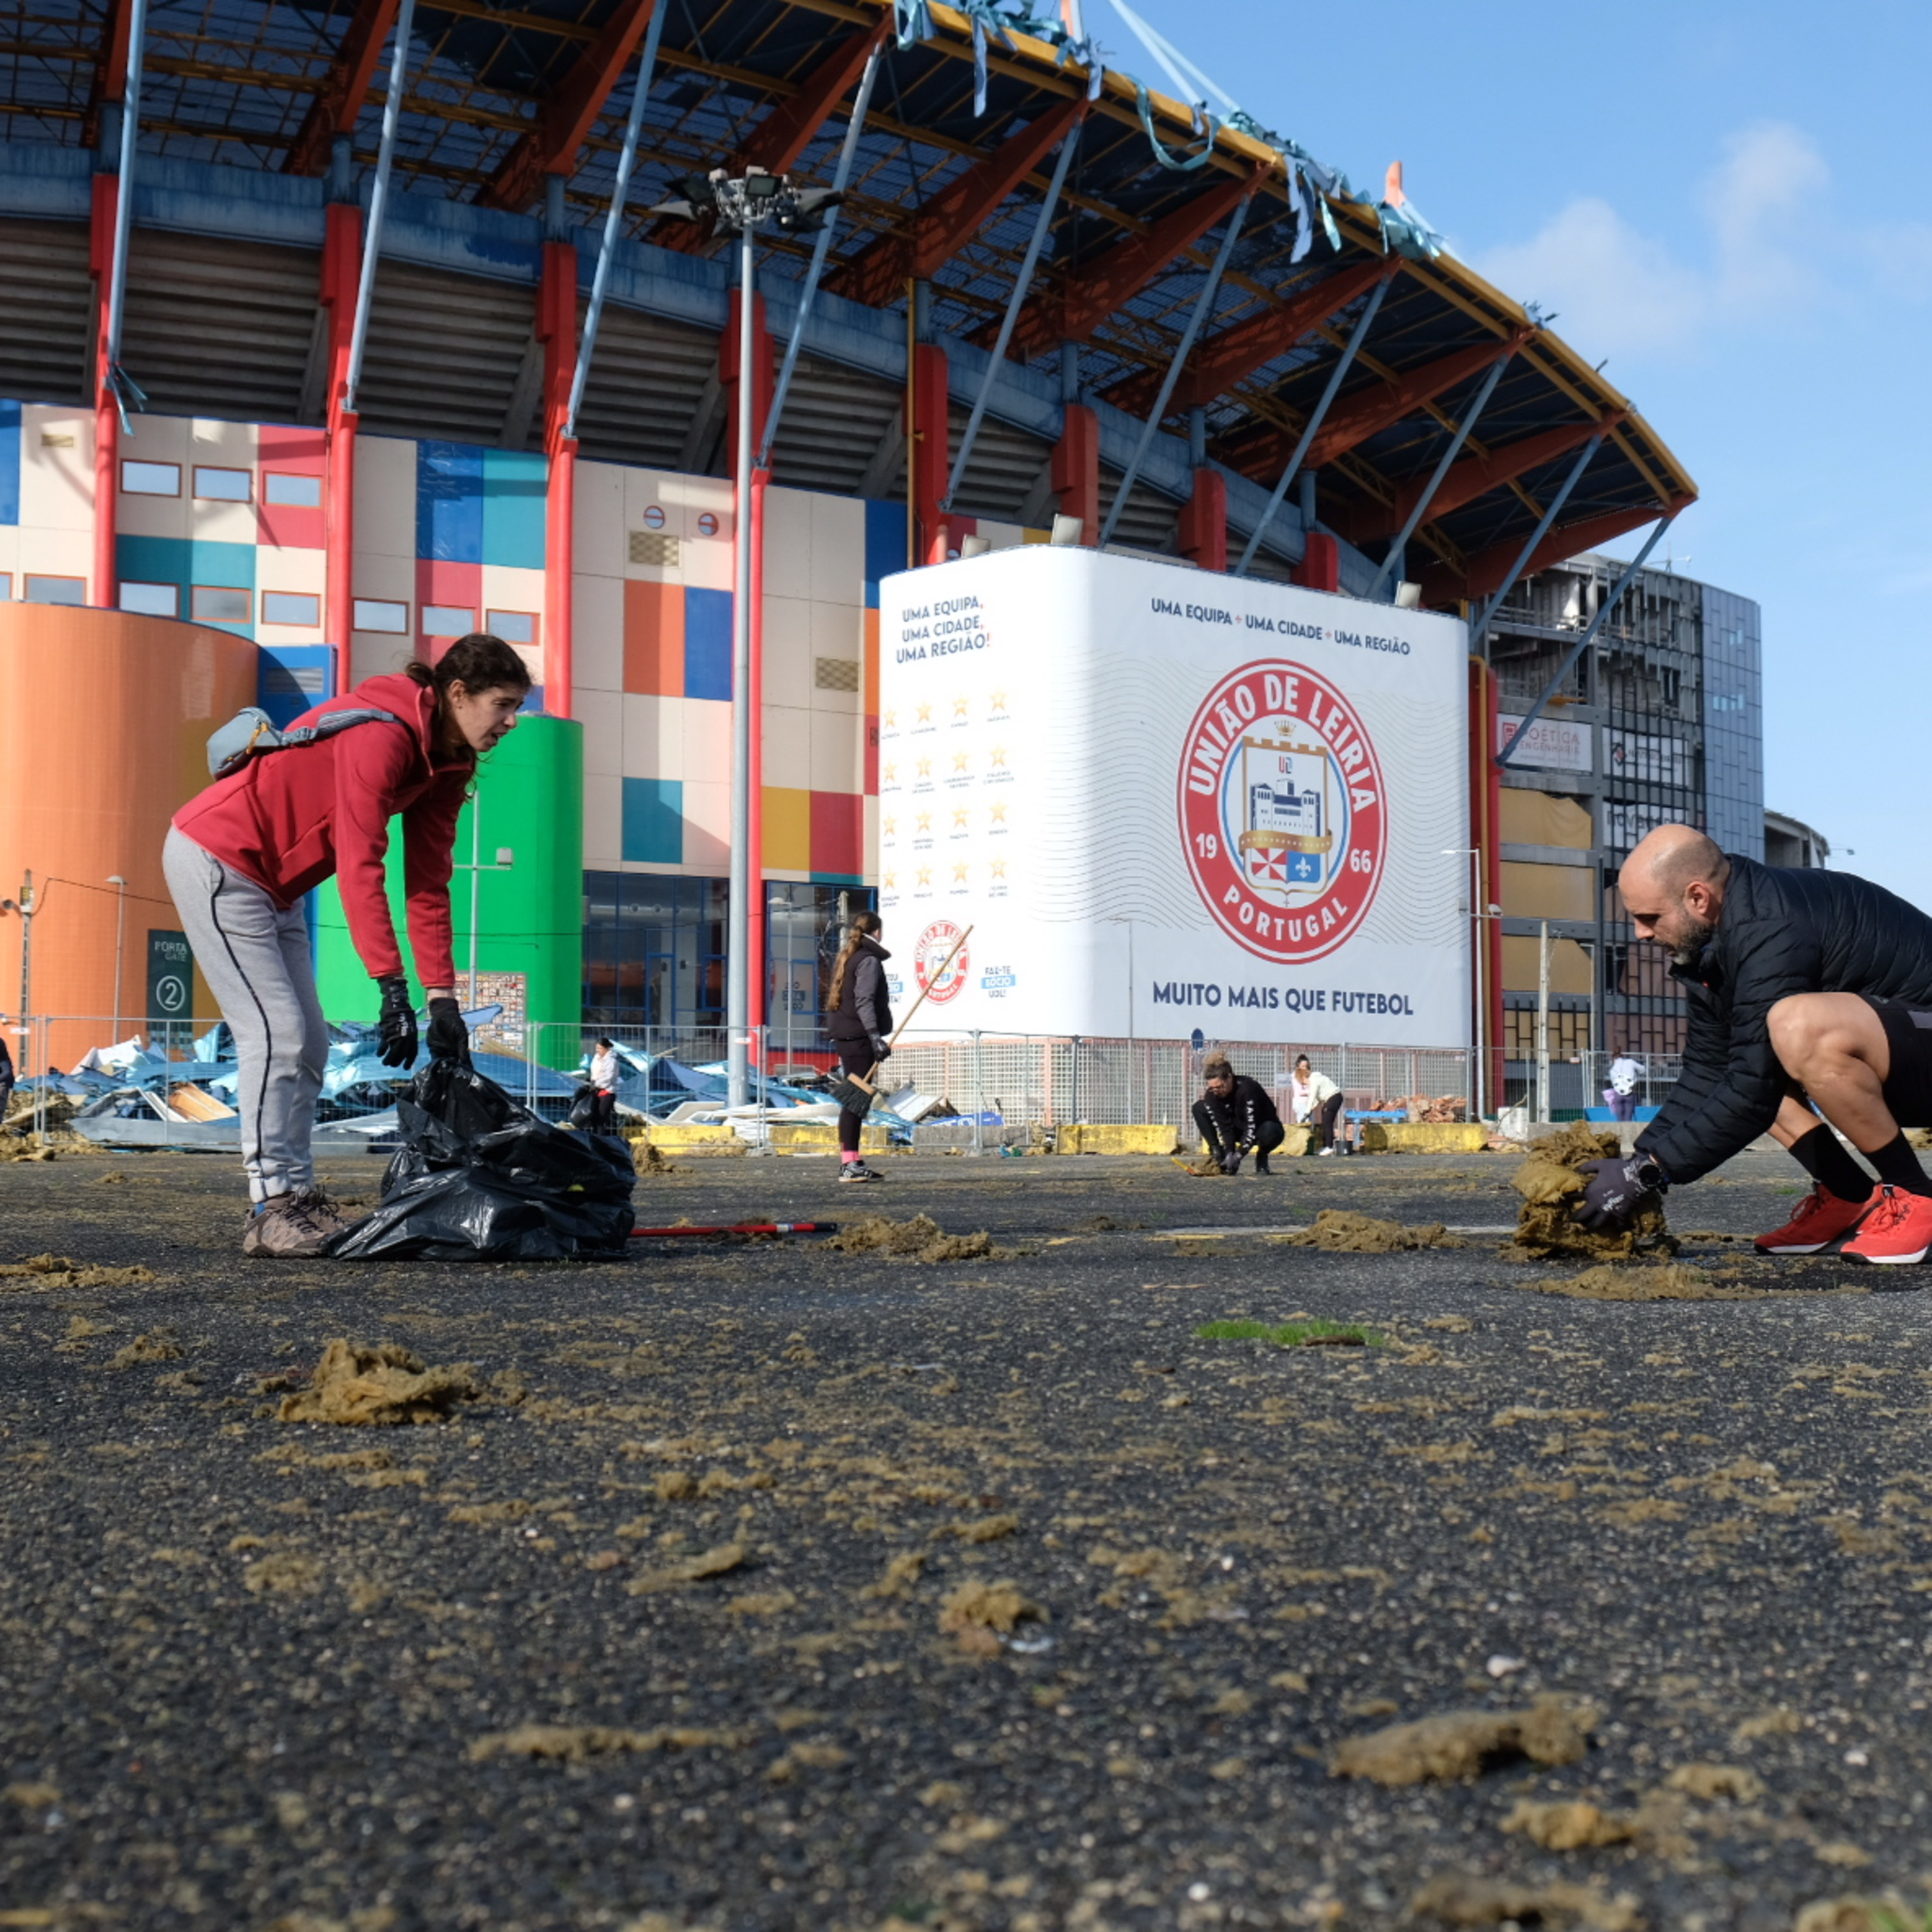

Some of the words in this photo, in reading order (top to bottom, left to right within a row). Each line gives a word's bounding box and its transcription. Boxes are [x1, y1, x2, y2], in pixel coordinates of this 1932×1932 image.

[902, 605, 930, 622] UMA
[934, 595, 983, 616] EQUIPA,
[902, 626, 930, 642] UMA
[934, 615, 983, 636] CIDADE,
[1151, 598, 1182, 616] UMA
[1186, 603, 1233, 625] EQUIPA
[1245, 614, 1275, 632] UMA
[1278, 620, 1323, 640] CIDADE
[1334, 629, 1362, 647] UMA
[1365, 636, 1410, 655] REGIÃO
[896, 645, 926, 663] UMA
[931, 631, 989, 658] REGIÃO!
[1189, 685, 1256, 795] UNIÃO
[1264, 674, 1299, 713] DE
[1308, 690, 1376, 813] LEIRIA
[1525, 726, 1580, 744] OÉTICA
[1196, 833, 1218, 859] 19
[1350, 848, 1372, 873] 66
[1224, 884, 1349, 942] PORTUGAL
[155, 941, 187, 954] PORTA
[165, 952, 186, 961] GATE
[165, 982, 177, 1005] 2
[1153, 981, 1221, 1007] MUITO
[1228, 985, 1279, 1009] MAIS
[1285, 988, 1326, 1014] QUE
[1332, 990, 1414, 1016] FUTEBOL
